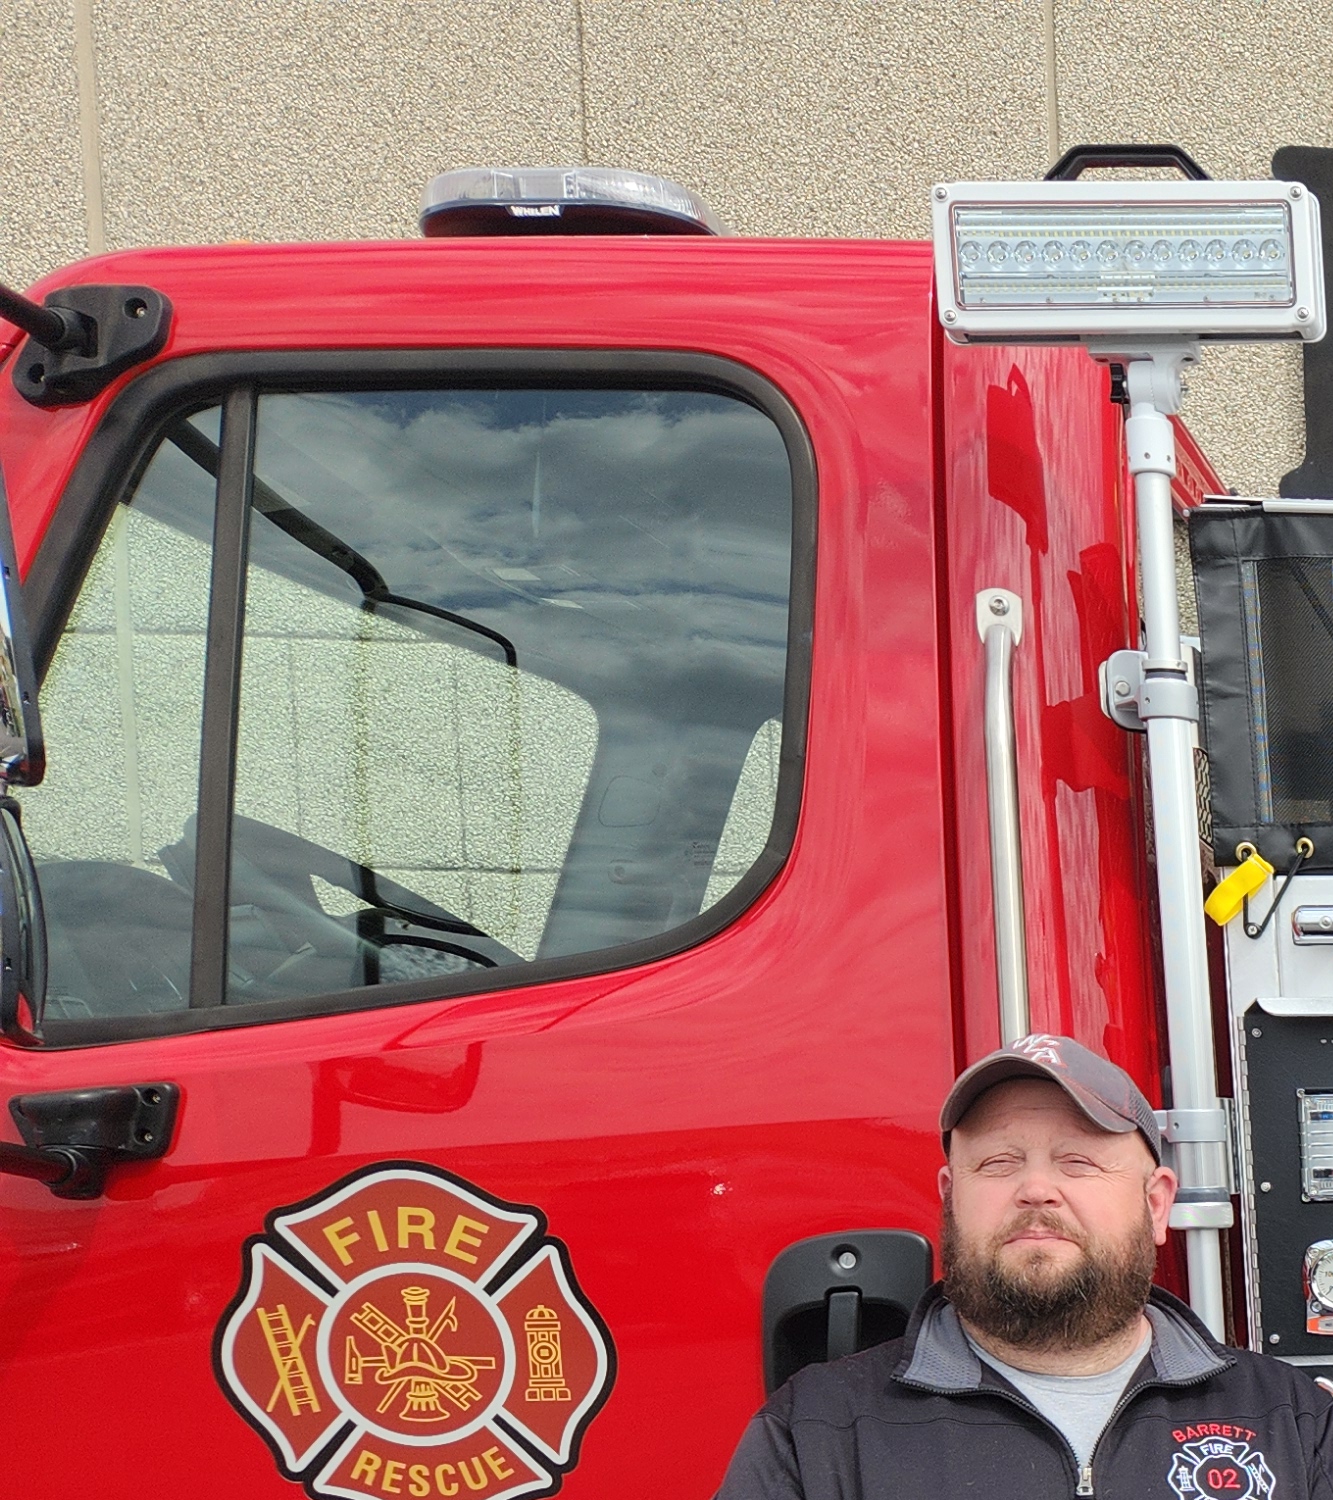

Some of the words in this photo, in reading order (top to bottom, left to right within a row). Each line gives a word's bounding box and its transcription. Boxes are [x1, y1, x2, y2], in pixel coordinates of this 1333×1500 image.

[322, 1206, 490, 1266] FIRE
[1171, 1423, 1256, 1443] BARRETT
[1199, 1443, 1234, 1456] FIRE
[350, 1445, 515, 1497] RESCUE
[1207, 1468, 1241, 1489] 02
